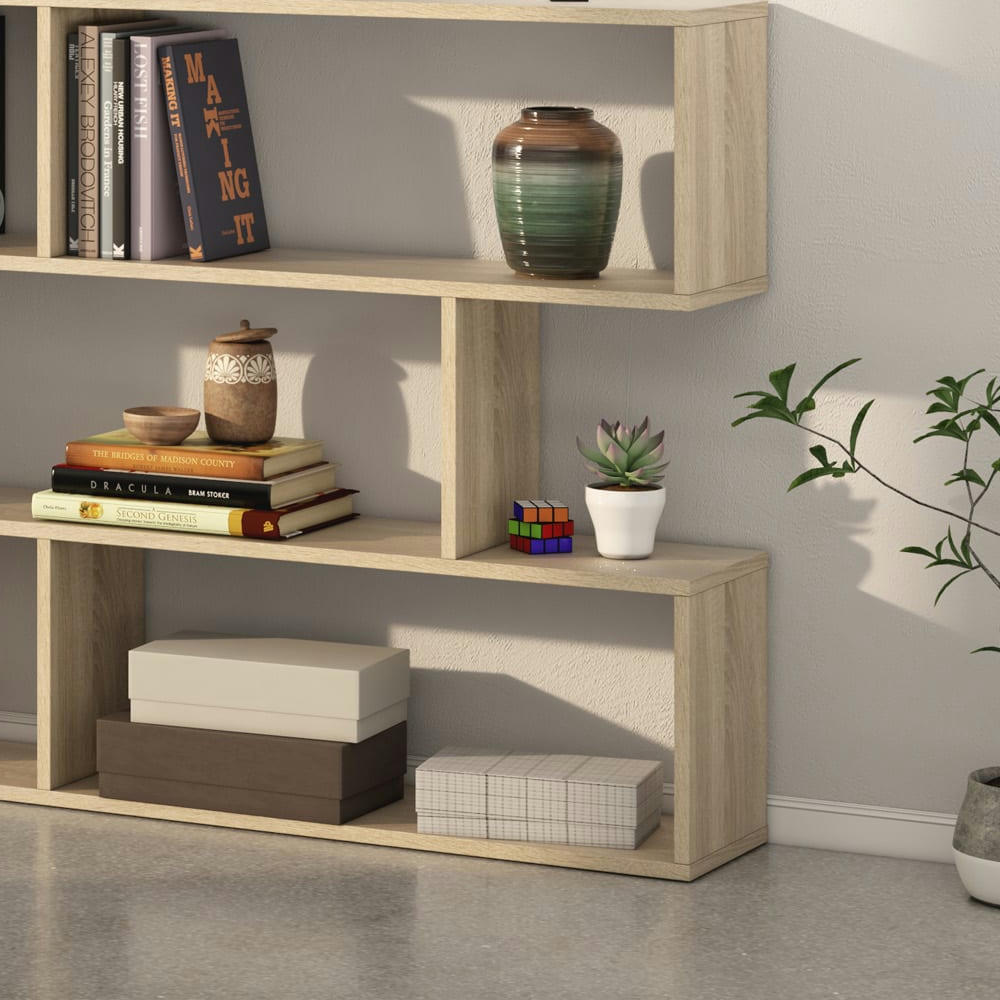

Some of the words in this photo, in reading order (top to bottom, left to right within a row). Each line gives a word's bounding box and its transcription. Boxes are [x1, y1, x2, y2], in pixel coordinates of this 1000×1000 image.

[80, 32, 96, 109] ALEXEY
[134, 42, 148, 92] LOST
[162, 56, 178, 111] MAKING
[170, 112, 181, 128] IT
[103, 100, 112, 144] Gardens
[134, 96, 148, 140] FISH
[103, 147, 112, 158] in
[80, 114, 96, 242] BRODOVITCH
[103, 160, 112, 198] France
[234, 212, 255, 246] IT
[93, 450, 110, 458] THE
[111, 452, 145, 462] BRIDGES
[147, 454, 158, 462] OF
[160, 455, 198, 466] MADISON
[200, 458, 236, 469] COUNTY
[90, 480, 172, 496] DRACULA
[188, 489, 206, 498] BRAM
[206, 490, 230, 500] STOKER
[116, 510, 156, 520] SECOND
[158, 512, 198, 524] GENESIS
